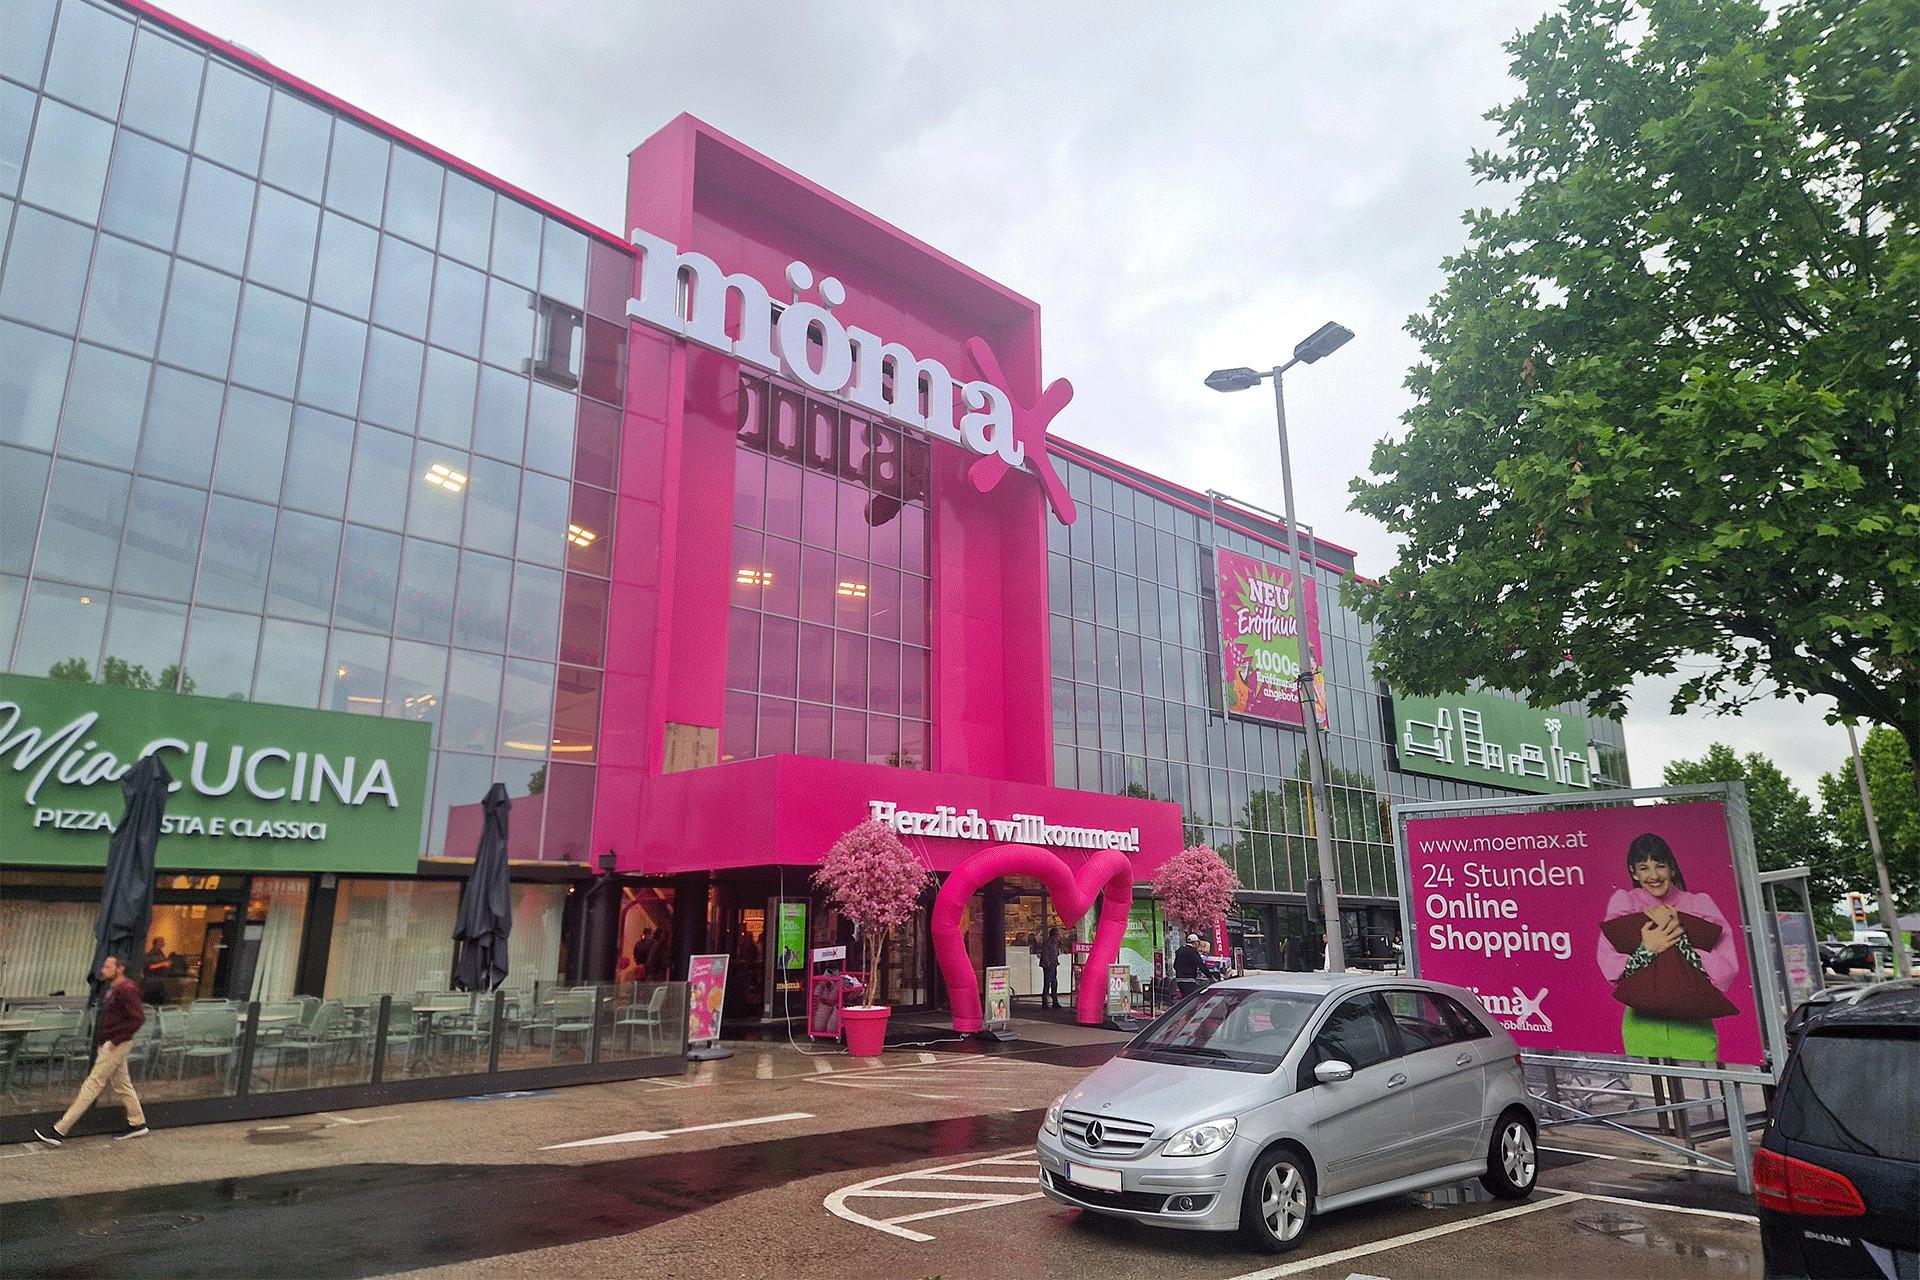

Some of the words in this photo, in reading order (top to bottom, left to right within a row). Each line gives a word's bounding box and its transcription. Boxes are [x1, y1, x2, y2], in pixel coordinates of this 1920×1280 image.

[1248, 577, 1290, 611] NEU
[1237, 606, 1298, 641] Eröffnun
[1263, 688, 1299, 703] angebote
[0, 701, 131, 805] Mia
[160, 815, 206, 835] STA
[209, 817, 225, 836] E
[229, 818, 327, 841] CLASSICI
[869, 800, 989, 840] Herzlich
[990, 814, 1140, 852] willkommen!
[1419, 831, 1589, 853] www.moemax.at
[1422, 863, 1455, 888] 24
[1463, 859, 1585, 888] Stunden
[1425, 893, 1518, 919] Online
[1429, 924, 1572, 960] Shopping
[1500, 1020, 1553, 1032] öbelhaus
